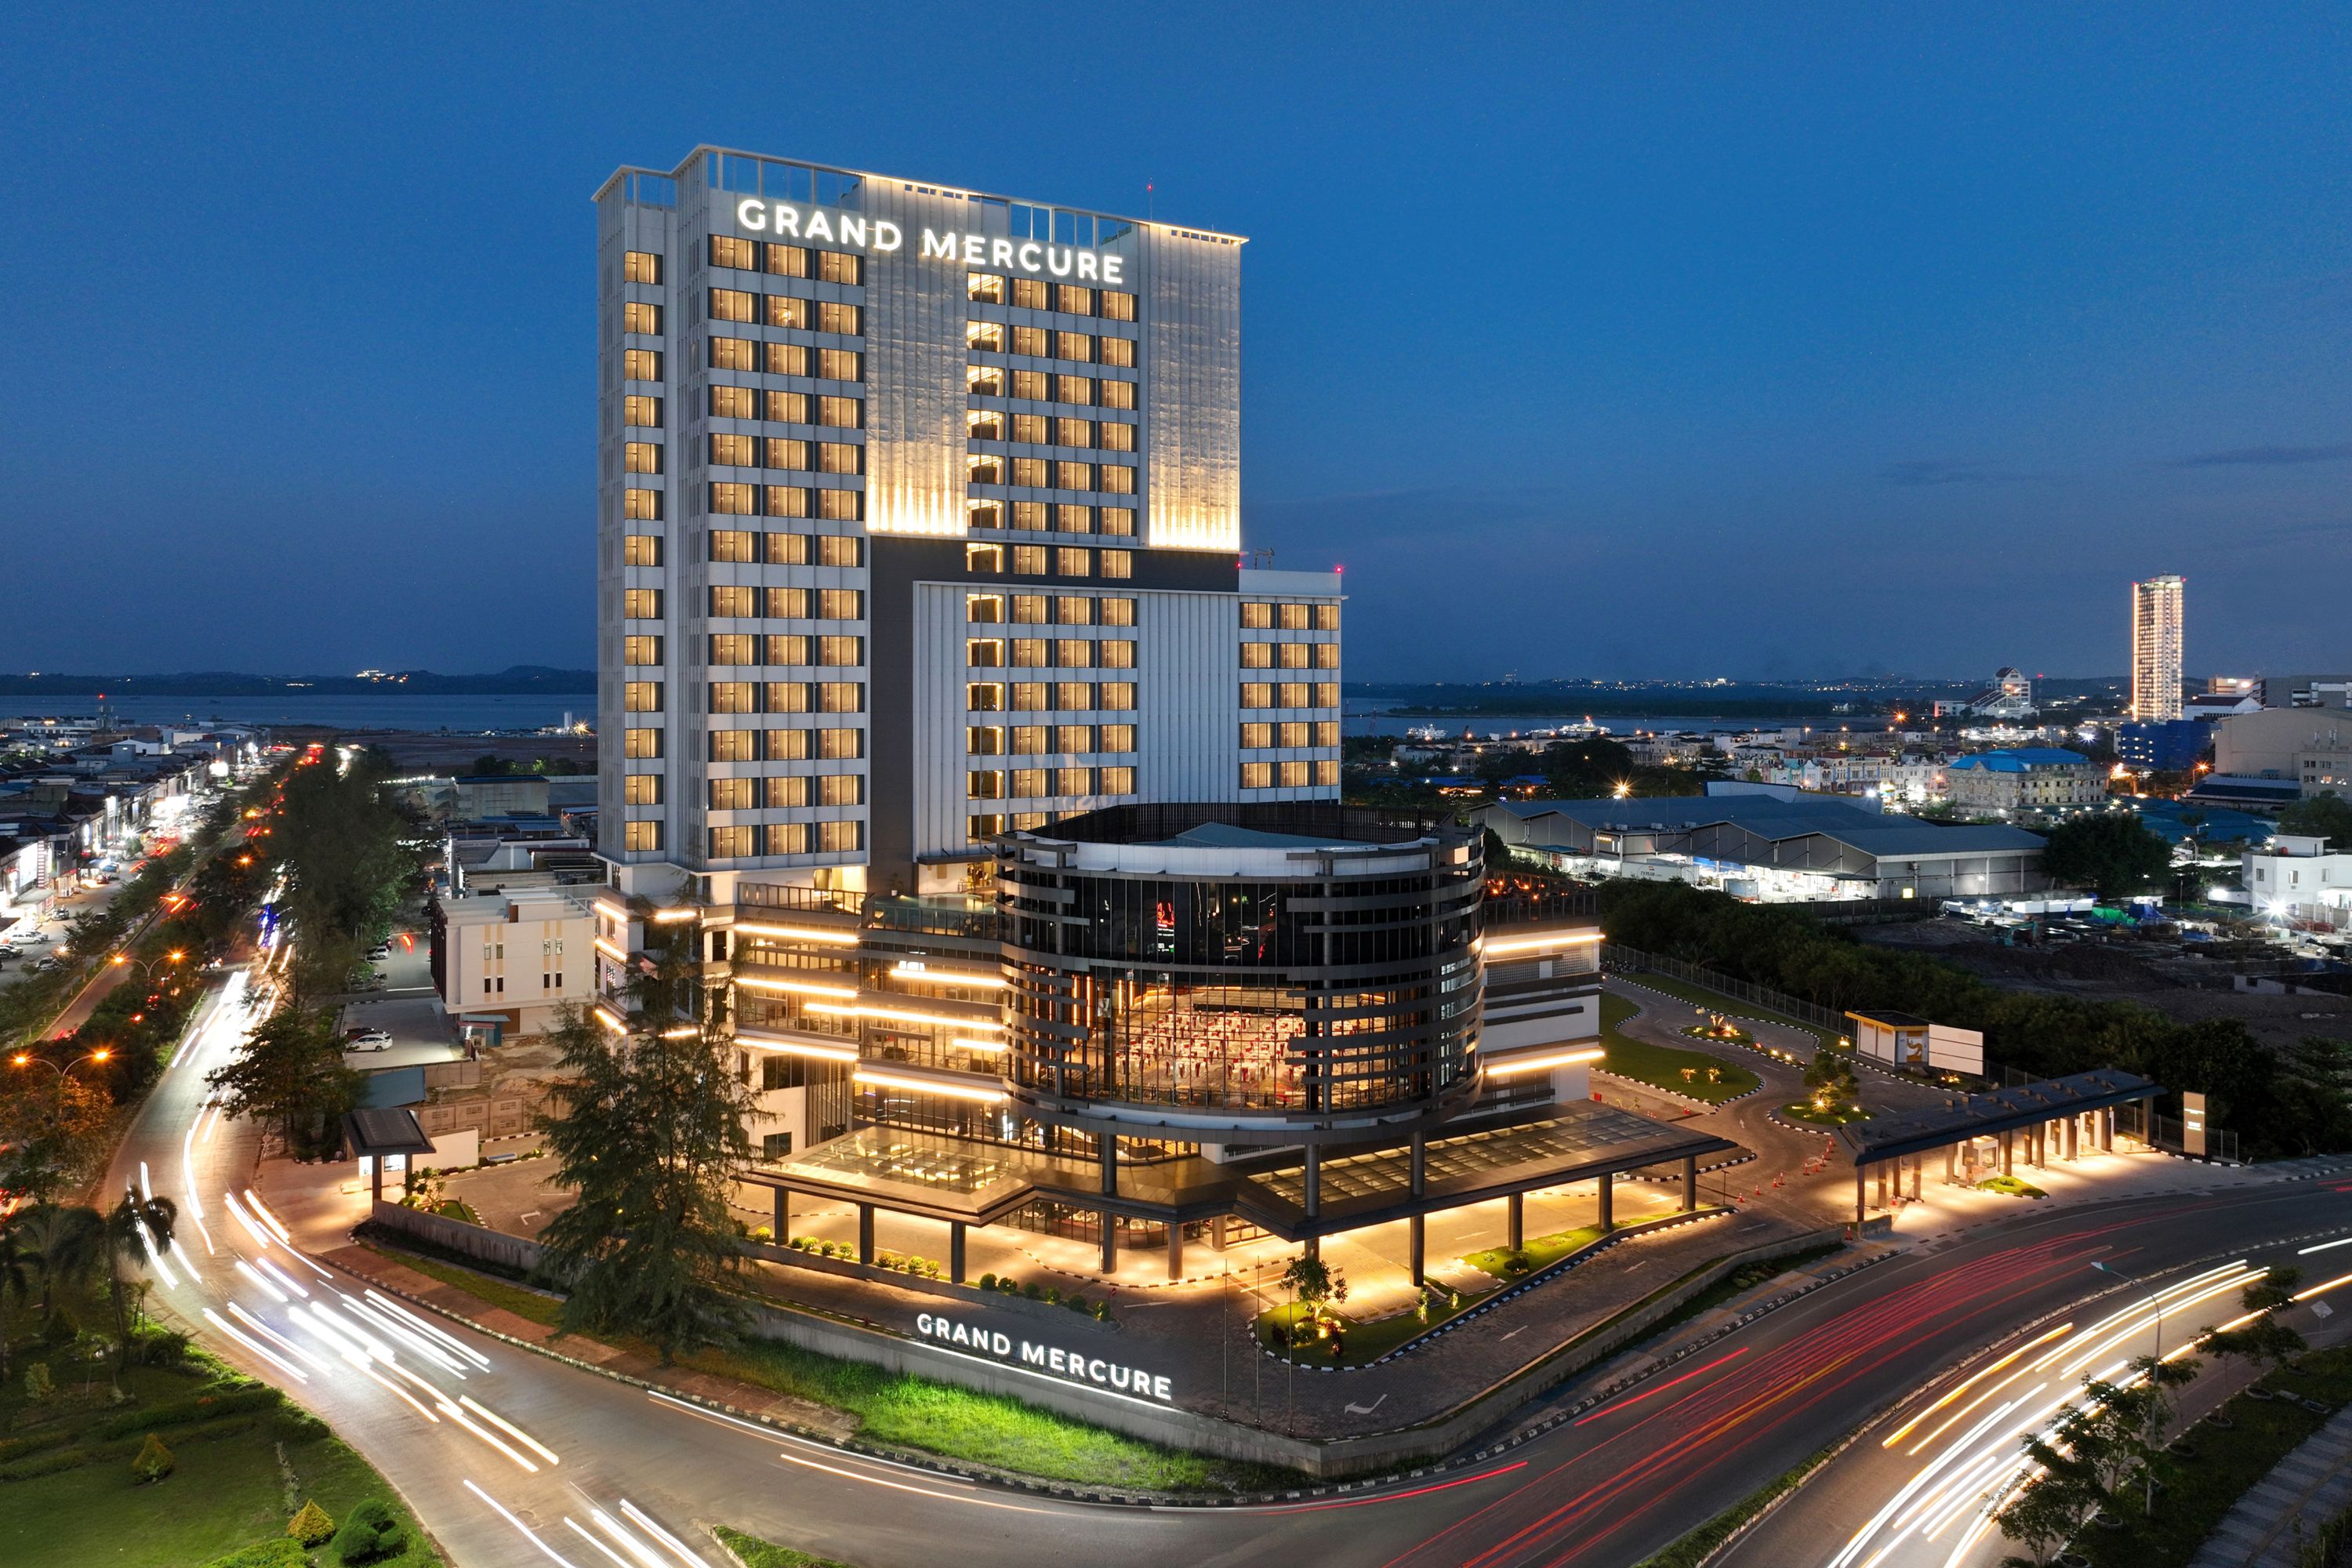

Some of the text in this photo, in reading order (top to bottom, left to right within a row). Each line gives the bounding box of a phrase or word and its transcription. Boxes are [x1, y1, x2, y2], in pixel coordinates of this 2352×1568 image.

[738, 198, 1123, 284] GRAND MERCURE
[916, 1313, 1172, 1401] GRAND MERCURE
